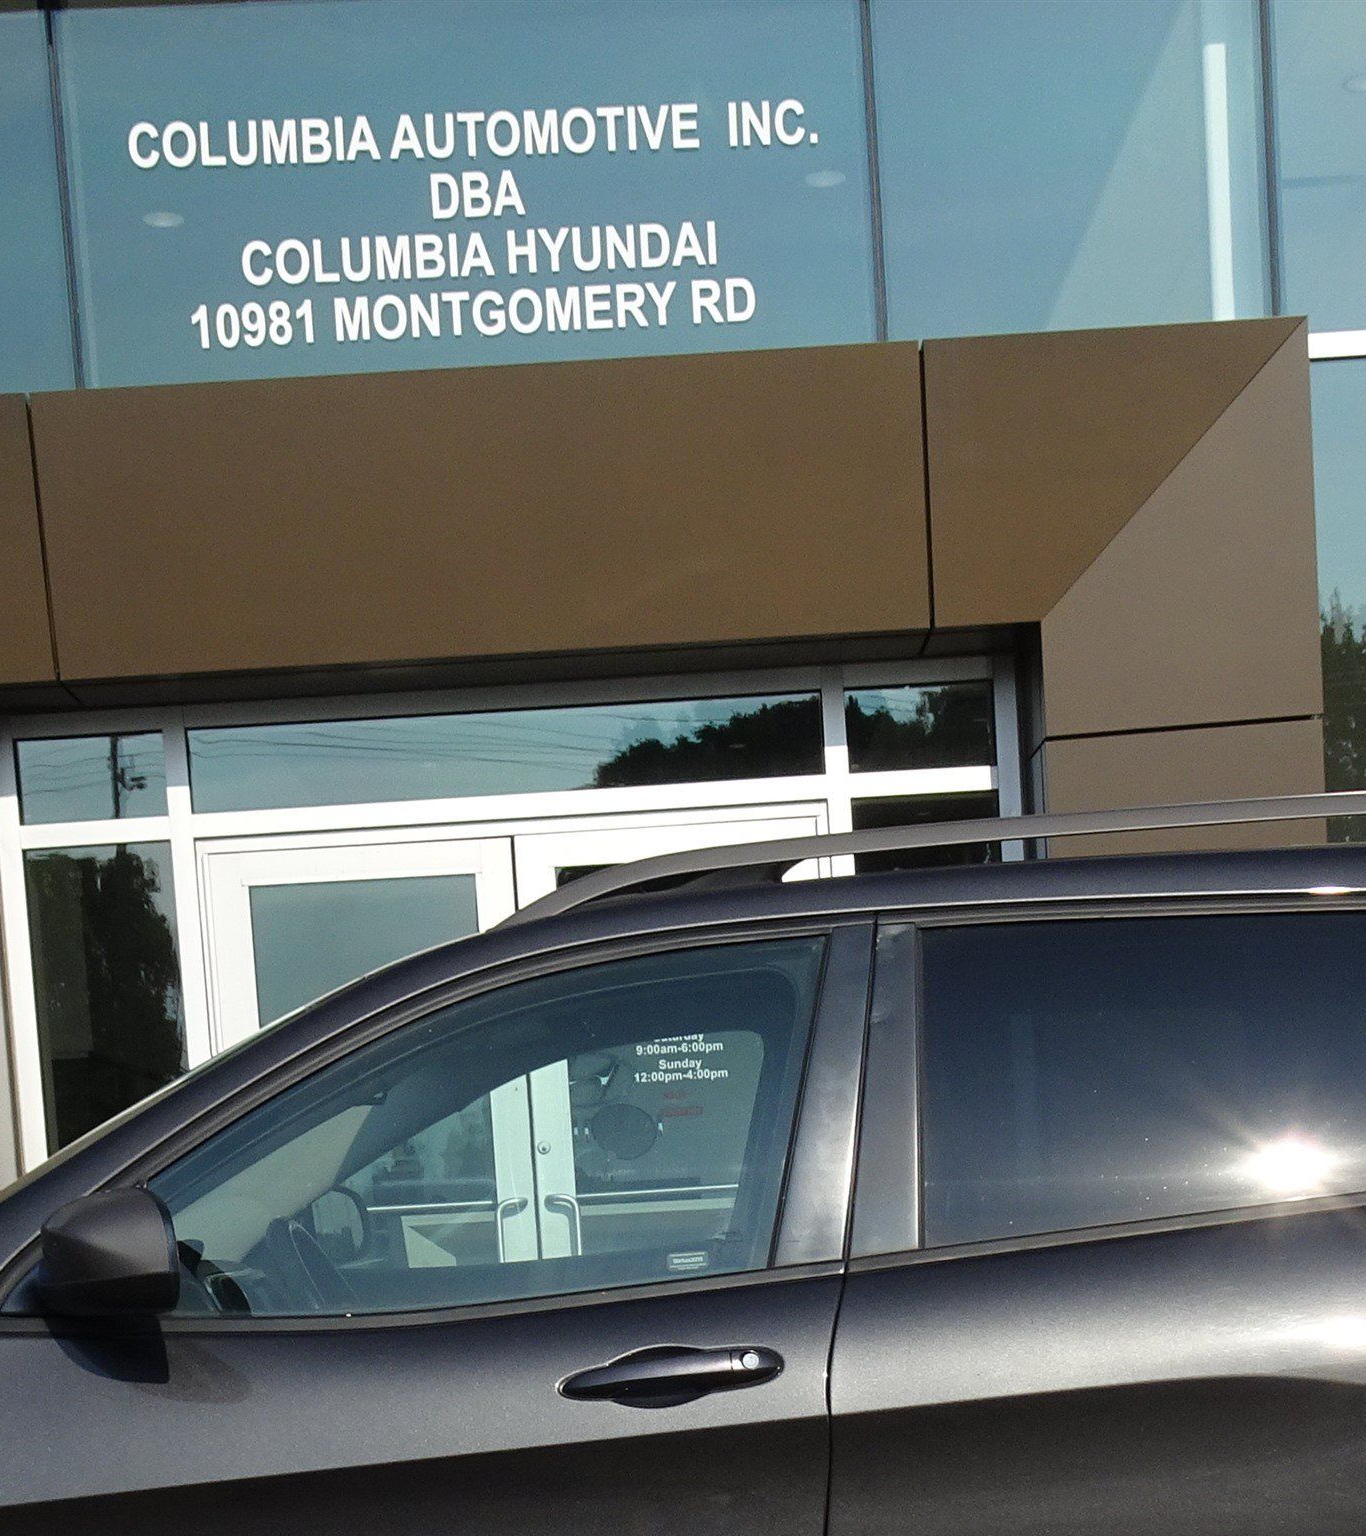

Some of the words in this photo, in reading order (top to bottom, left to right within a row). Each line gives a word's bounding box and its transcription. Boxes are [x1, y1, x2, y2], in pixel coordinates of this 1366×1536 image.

[128, 115, 381, 169] COLUMBIA
[390, 103, 700, 159] AUTOMOTIVE
[727, 99, 819, 147] INC.
[430, 169, 526, 219] DBA
[241, 232, 495, 286] COLUMBIA
[506, 220, 718, 275] HYUNDAI
[191, 298, 315, 349] 10981
[334, 281, 676, 342] MONTGOMERY
[691, 277, 757, 325] RD
[636, 1042, 724, 1056] 9:00am-6:00pm
[658, 1058, 703, 1070] Sunday
[634, 1068, 729, 1083] 12:00pm-4:00pm
